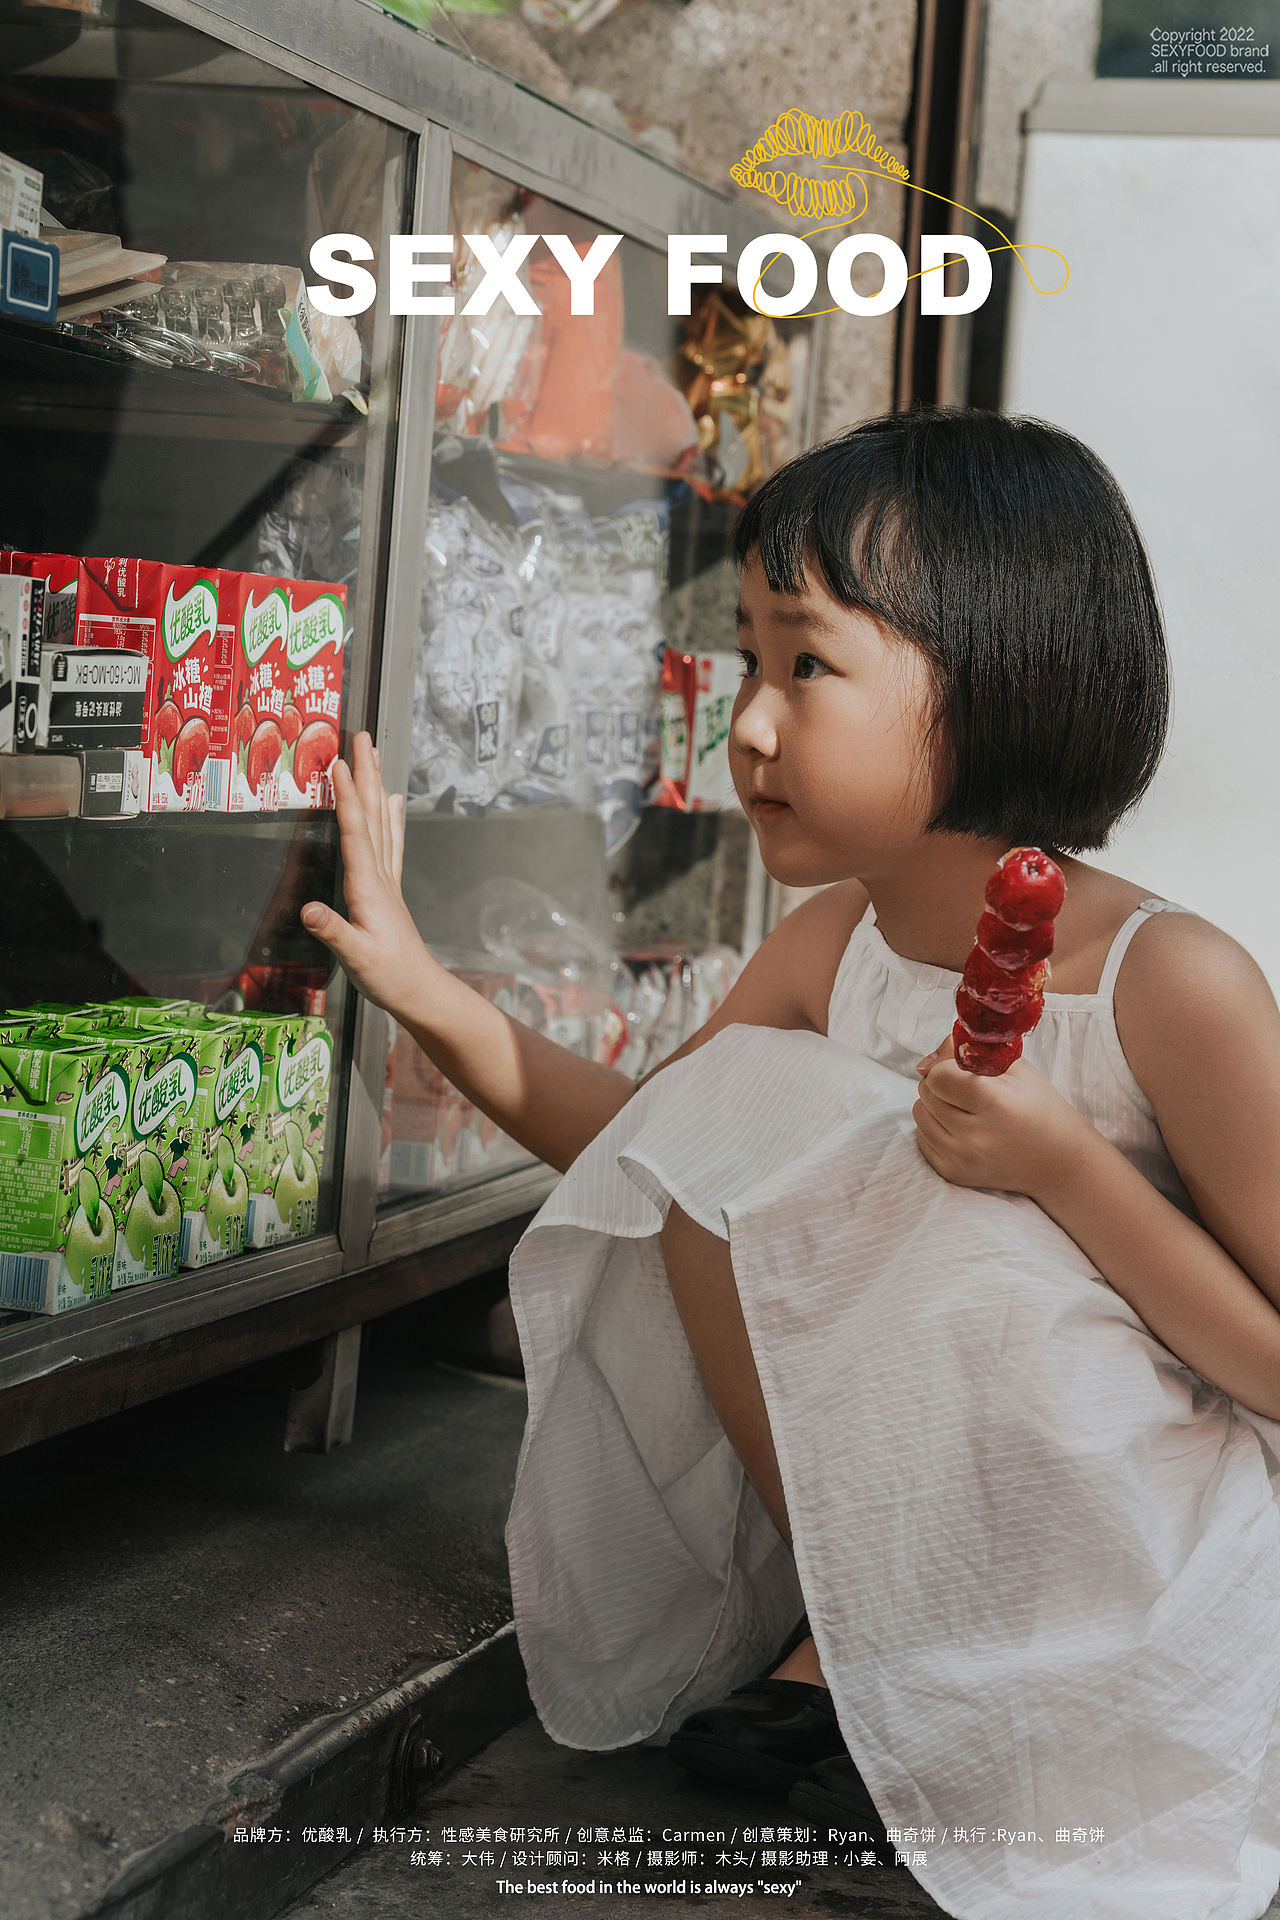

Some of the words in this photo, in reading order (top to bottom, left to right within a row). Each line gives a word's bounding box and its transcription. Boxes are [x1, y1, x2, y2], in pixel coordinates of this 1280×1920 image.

[170, 590, 211, 648] 优酸乳
[249, 598, 282, 653] 优酸乳
[290, 602, 336, 656] 优酸乳
[75, 664, 142, 685] MC-150-MO-BK
[173, 657, 201, 692] 冰糖
[250, 662, 273, 696] 冰糖
[293, 664, 326, 698] 冰糖
[184, 681, 213, 716] 山楂
[257, 685, 285, 719] 山楂
[306, 687, 341, 720] 山楂
[218, 1051, 255, 1113] 优酸乳
[283, 1041, 325, 1100] 优酸乳
[80, 1075, 120, 1145] 优酸乳
[138, 1062, 187, 1128] 优酸乳
[9, 1299, 43, 1312] 500010
